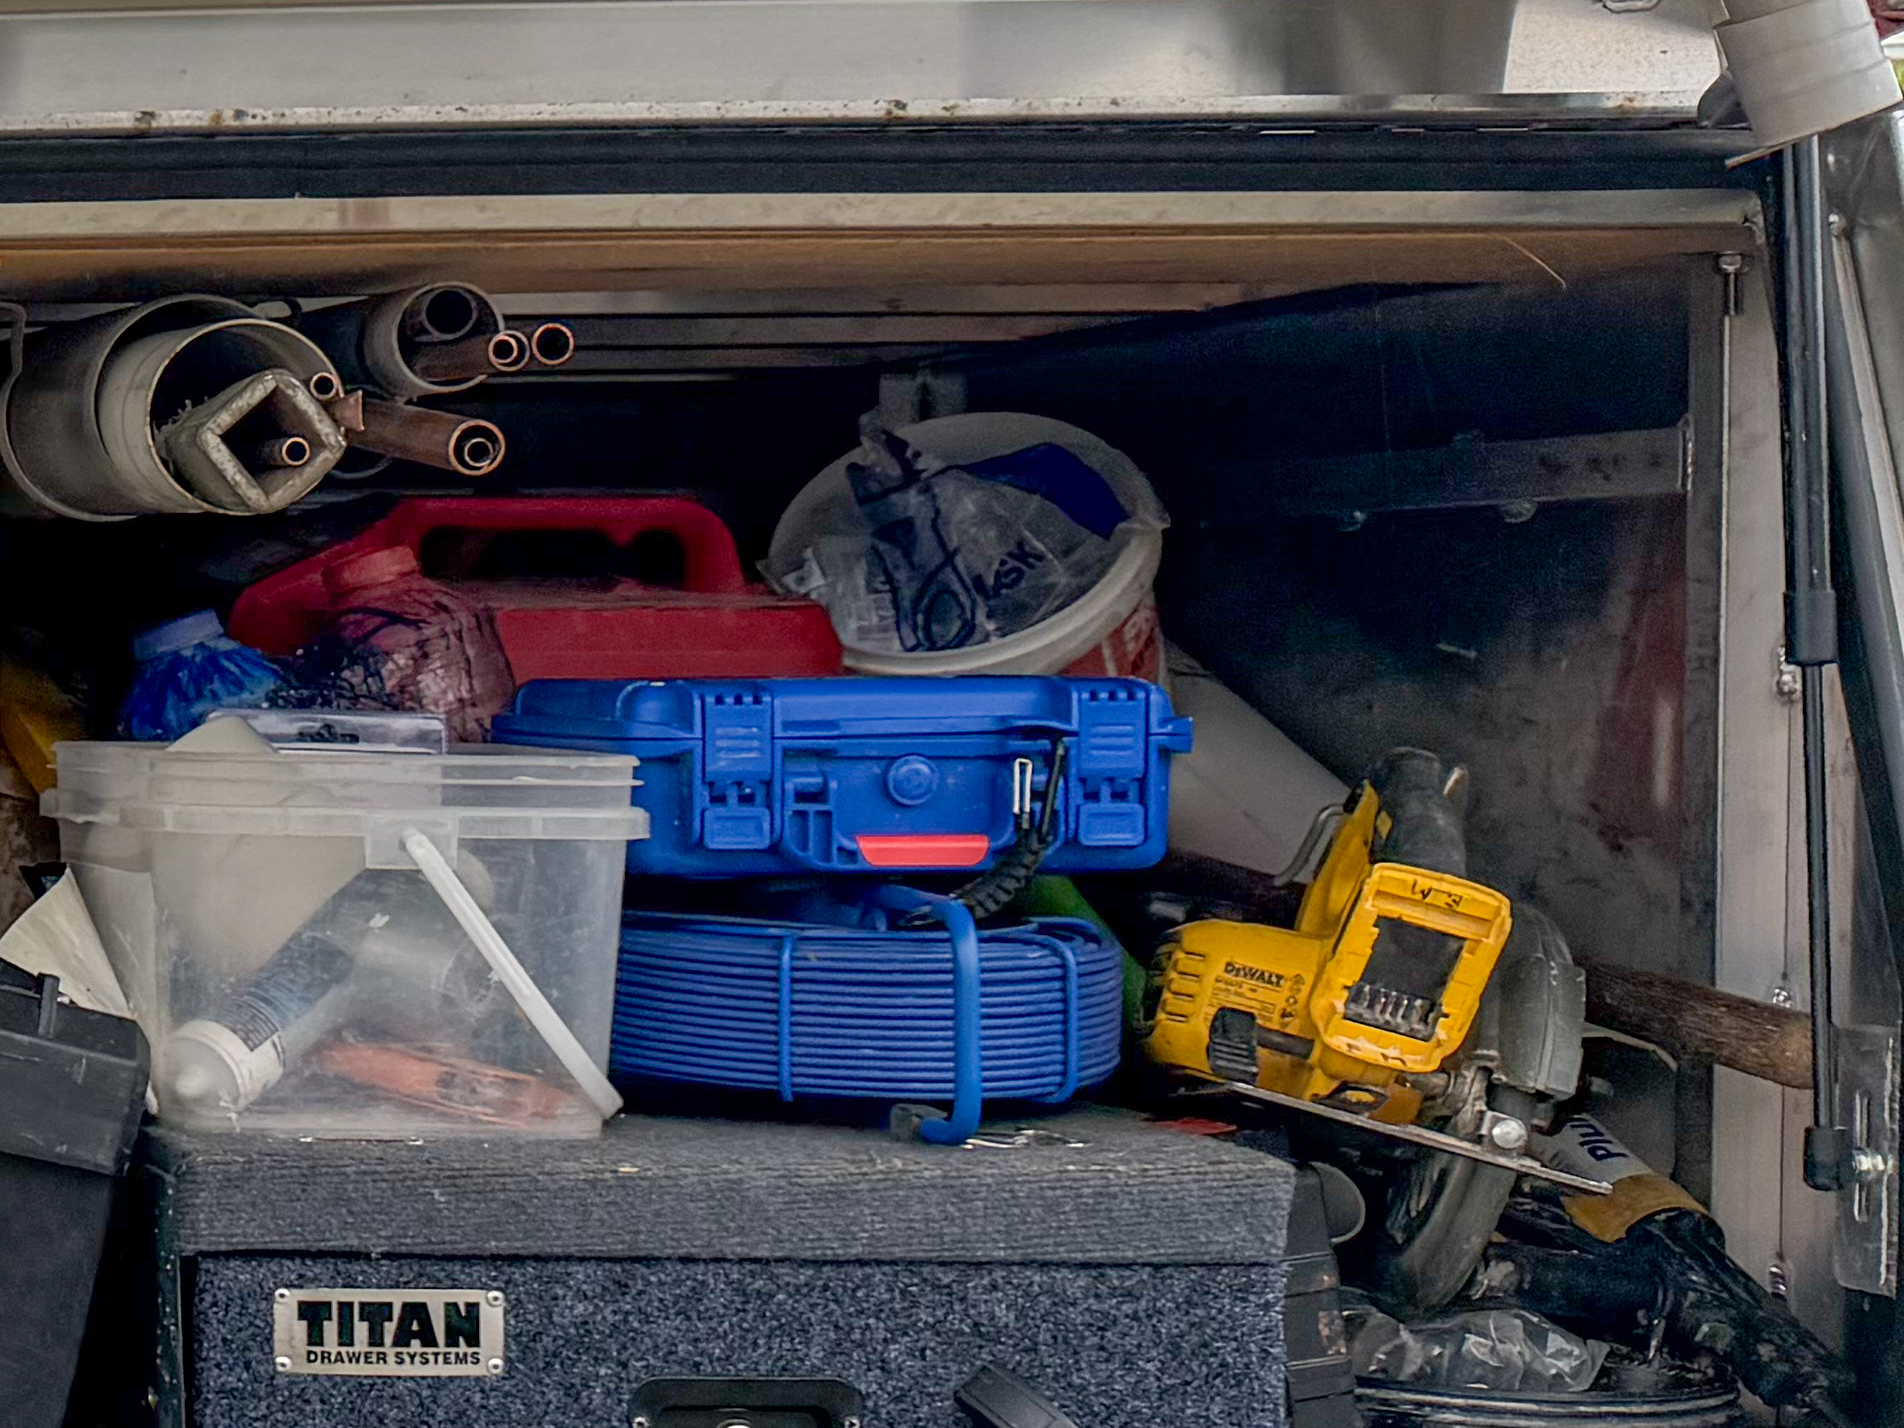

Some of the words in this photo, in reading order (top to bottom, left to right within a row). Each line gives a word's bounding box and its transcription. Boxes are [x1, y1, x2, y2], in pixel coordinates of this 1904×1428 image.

[297, 1300, 481, 1348] TITAN
[306, 1349, 388, 1365] DRAWER
[394, 1350, 481, 1366] SYSTEMS
